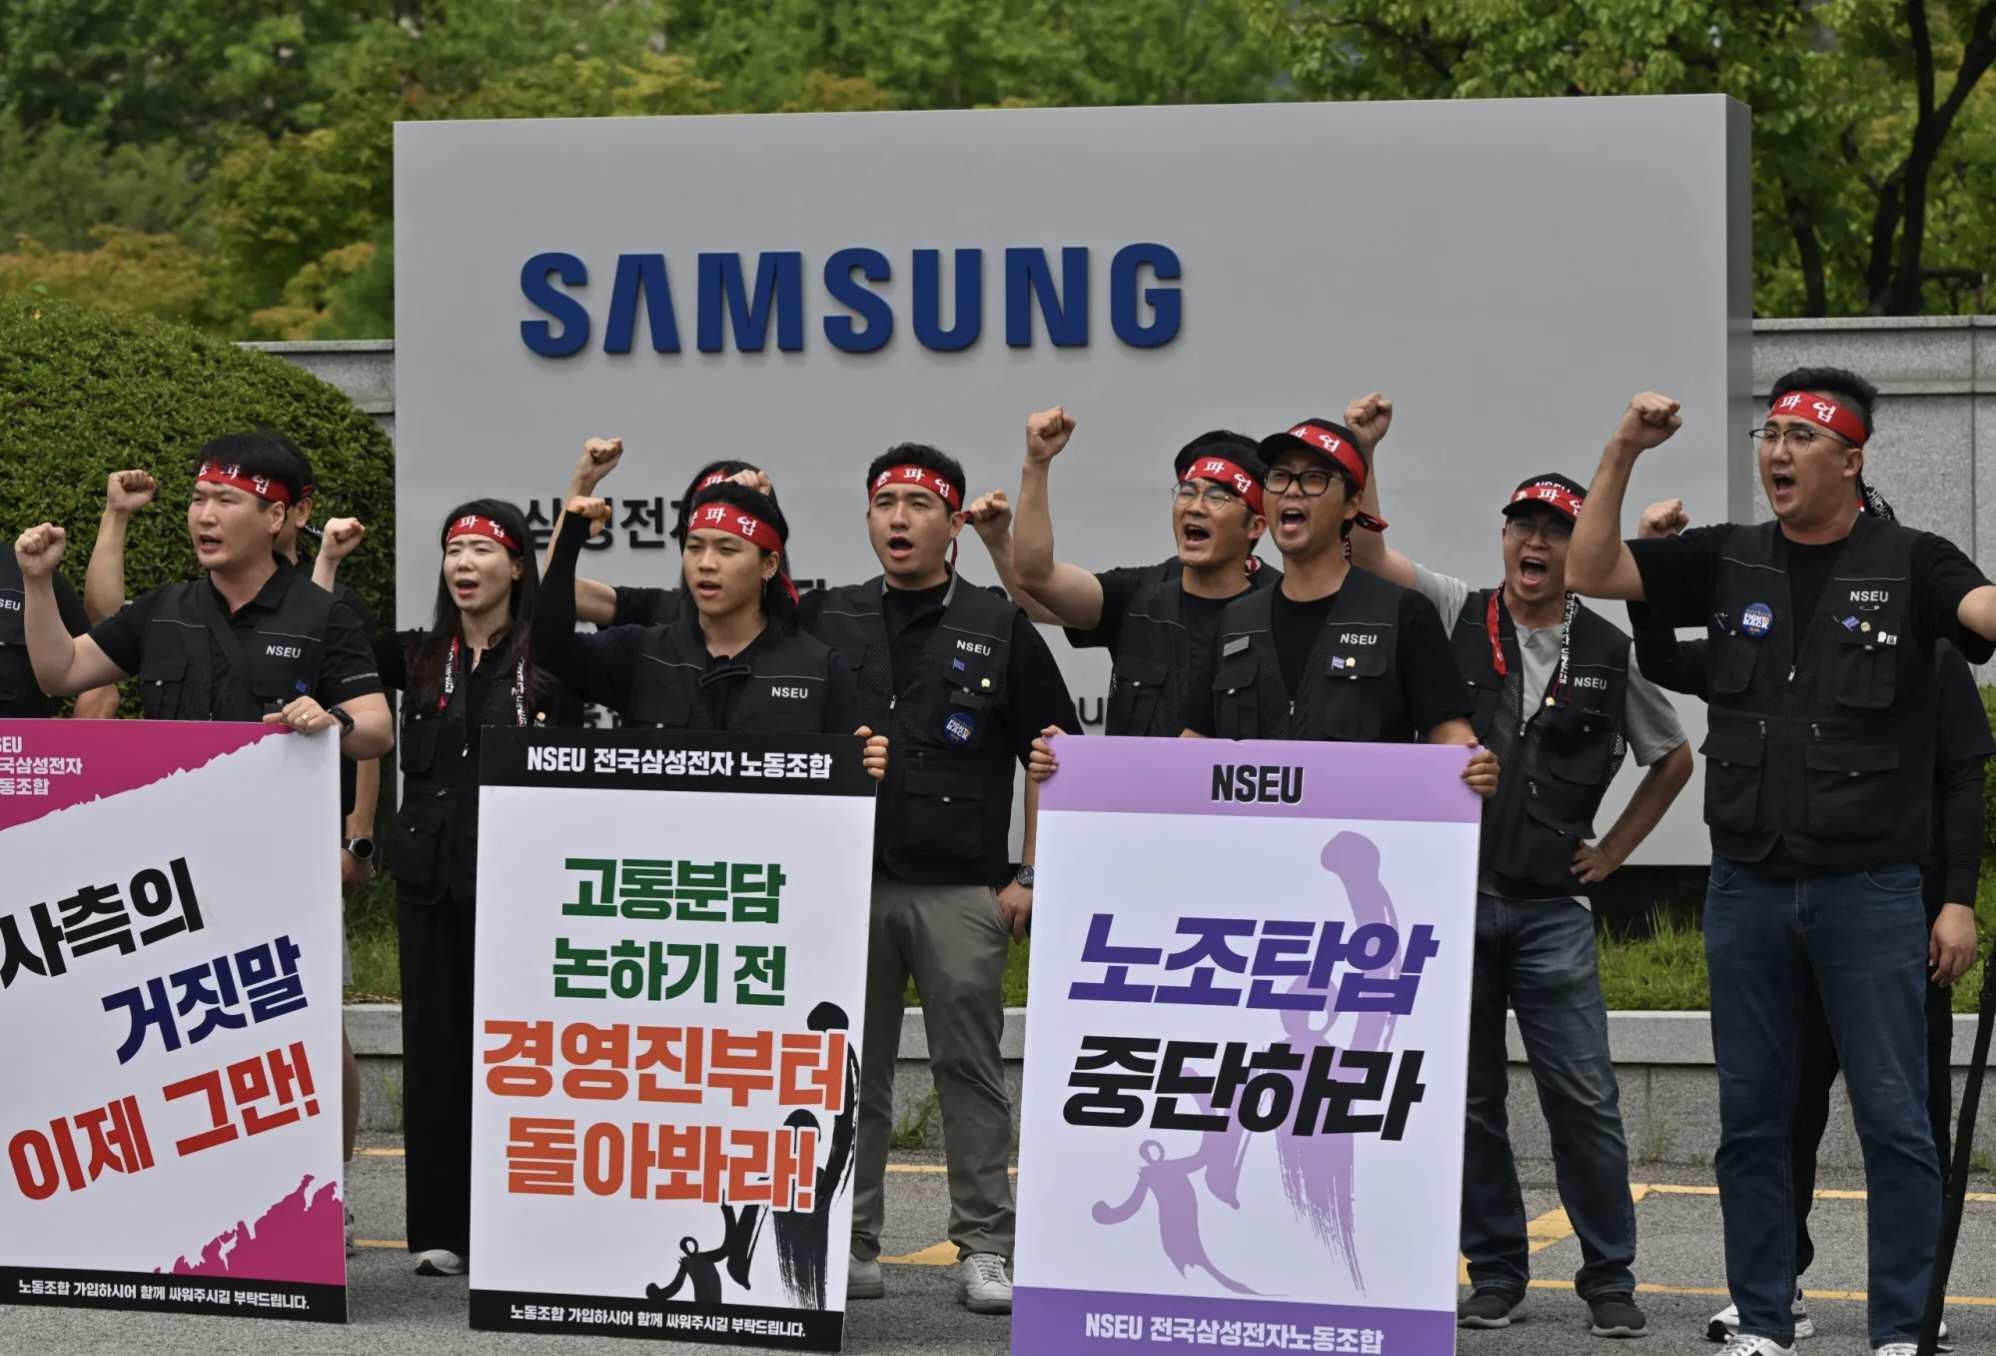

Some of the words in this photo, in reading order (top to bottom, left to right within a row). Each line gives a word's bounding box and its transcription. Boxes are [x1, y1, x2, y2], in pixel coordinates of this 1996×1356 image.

[520, 243, 1182, 358] SAMSUNG
[1849, 591, 1889, 602] NSEU
[265, 645, 301, 658] NSEU
[956, 639, 991, 657] NSEU
[1340, 633, 1378, 645] NSEU
[771, 686, 808, 699] NSEU
[1574, 677, 1607, 690] NSEU
[0, 736, 22, 753] EU
[527, 746, 586, 772] NSEU
[593, 748, 734, 776] 전국삼성전자
[740, 752, 832, 779] 노동조합
[1211, 764, 1304, 805] NSEU
[562, 857, 787, 924] 고통분담
[0, 857, 204, 989] 사측의
[552, 937, 719, 1004] 논하기
[734, 944, 787, 1006] 전
[1068, 912, 1440, 1015] 노조탄압
[101, 935, 308, 1065] 거짓말
[483, 1019, 849, 1112] 경영진부터
[1062, 1035, 1426, 1141] 중단하라
[8, 1095, 154, 1200] 이제
[162, 1041, 320, 1157] 그만!
[506, 1116, 819, 1210] 돌아봐라!
[19, 1279, 69, 1296] 노동조합
[73, 1281, 137, 1299] 가입하시어
[140, 1284, 165, 1301] 함께
[168, 1287, 231, 1305] 싸워주시길
[233, 1291, 310, 1310] 부탁드립니다.
[510, 1304, 564, 1321] 노동조합
[568, 1307, 634, 1326] 가입하시어
[637, 1311, 663, 1327] 함께
[666, 1312, 728, 1332] 싸워주시길
[731, 1316, 806, 1338] 부탁드립니다.
[1085, 1312, 1143, 1340] NSEU
[1150, 1316, 1385, 1355] 전국삼성전자노동조합
